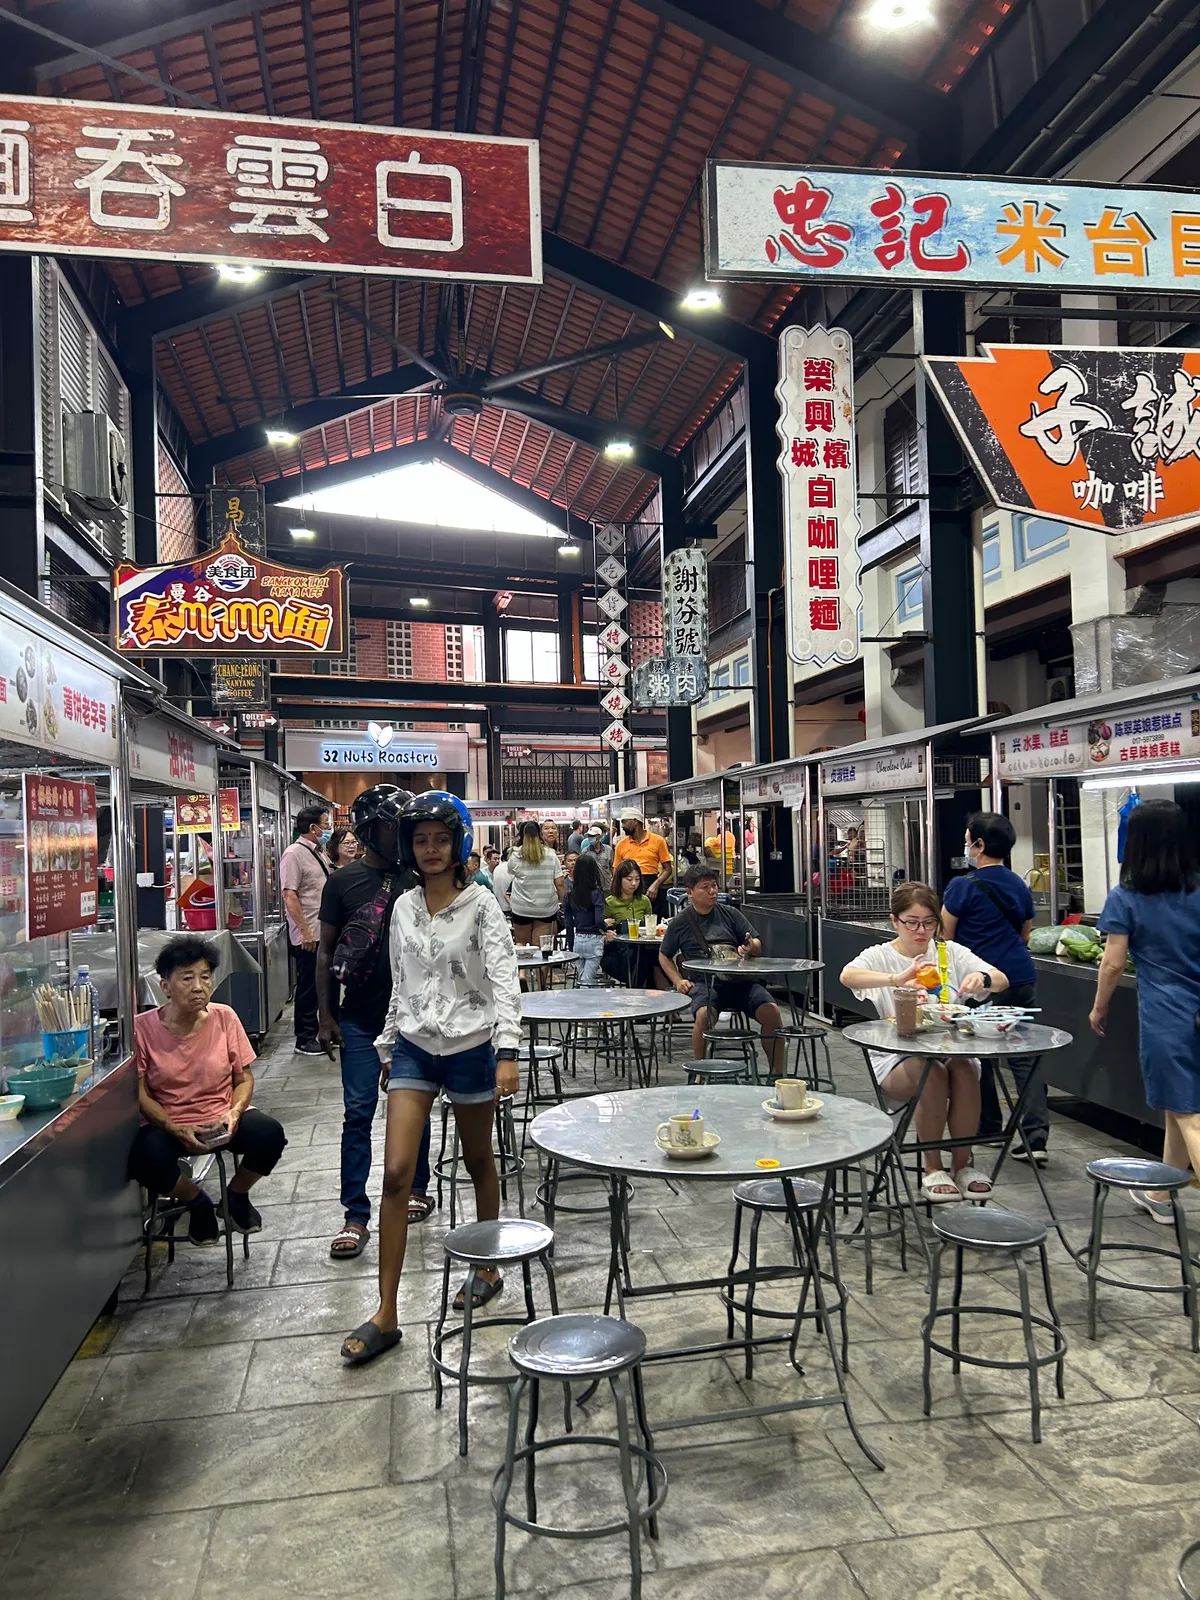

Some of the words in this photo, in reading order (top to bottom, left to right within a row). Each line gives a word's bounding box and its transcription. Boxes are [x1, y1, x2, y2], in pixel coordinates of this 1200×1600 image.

[765, 176, 973, 273] 忠記
[1071, 469, 1165, 514] 咖啡
[206, 564, 256, 579] 美食团
[261, 575, 308, 588] BANGKOK
[169, 582, 214, 603] 曼谷
[270, 586, 300, 599] MAMA
[301, 586, 325, 599] MEE
[241, 713, 264, 722] TOILET
[323, 750, 339, 764] 32
[344, 750, 374, 764] Nuts
[379, 750, 438, 767] Roastery
